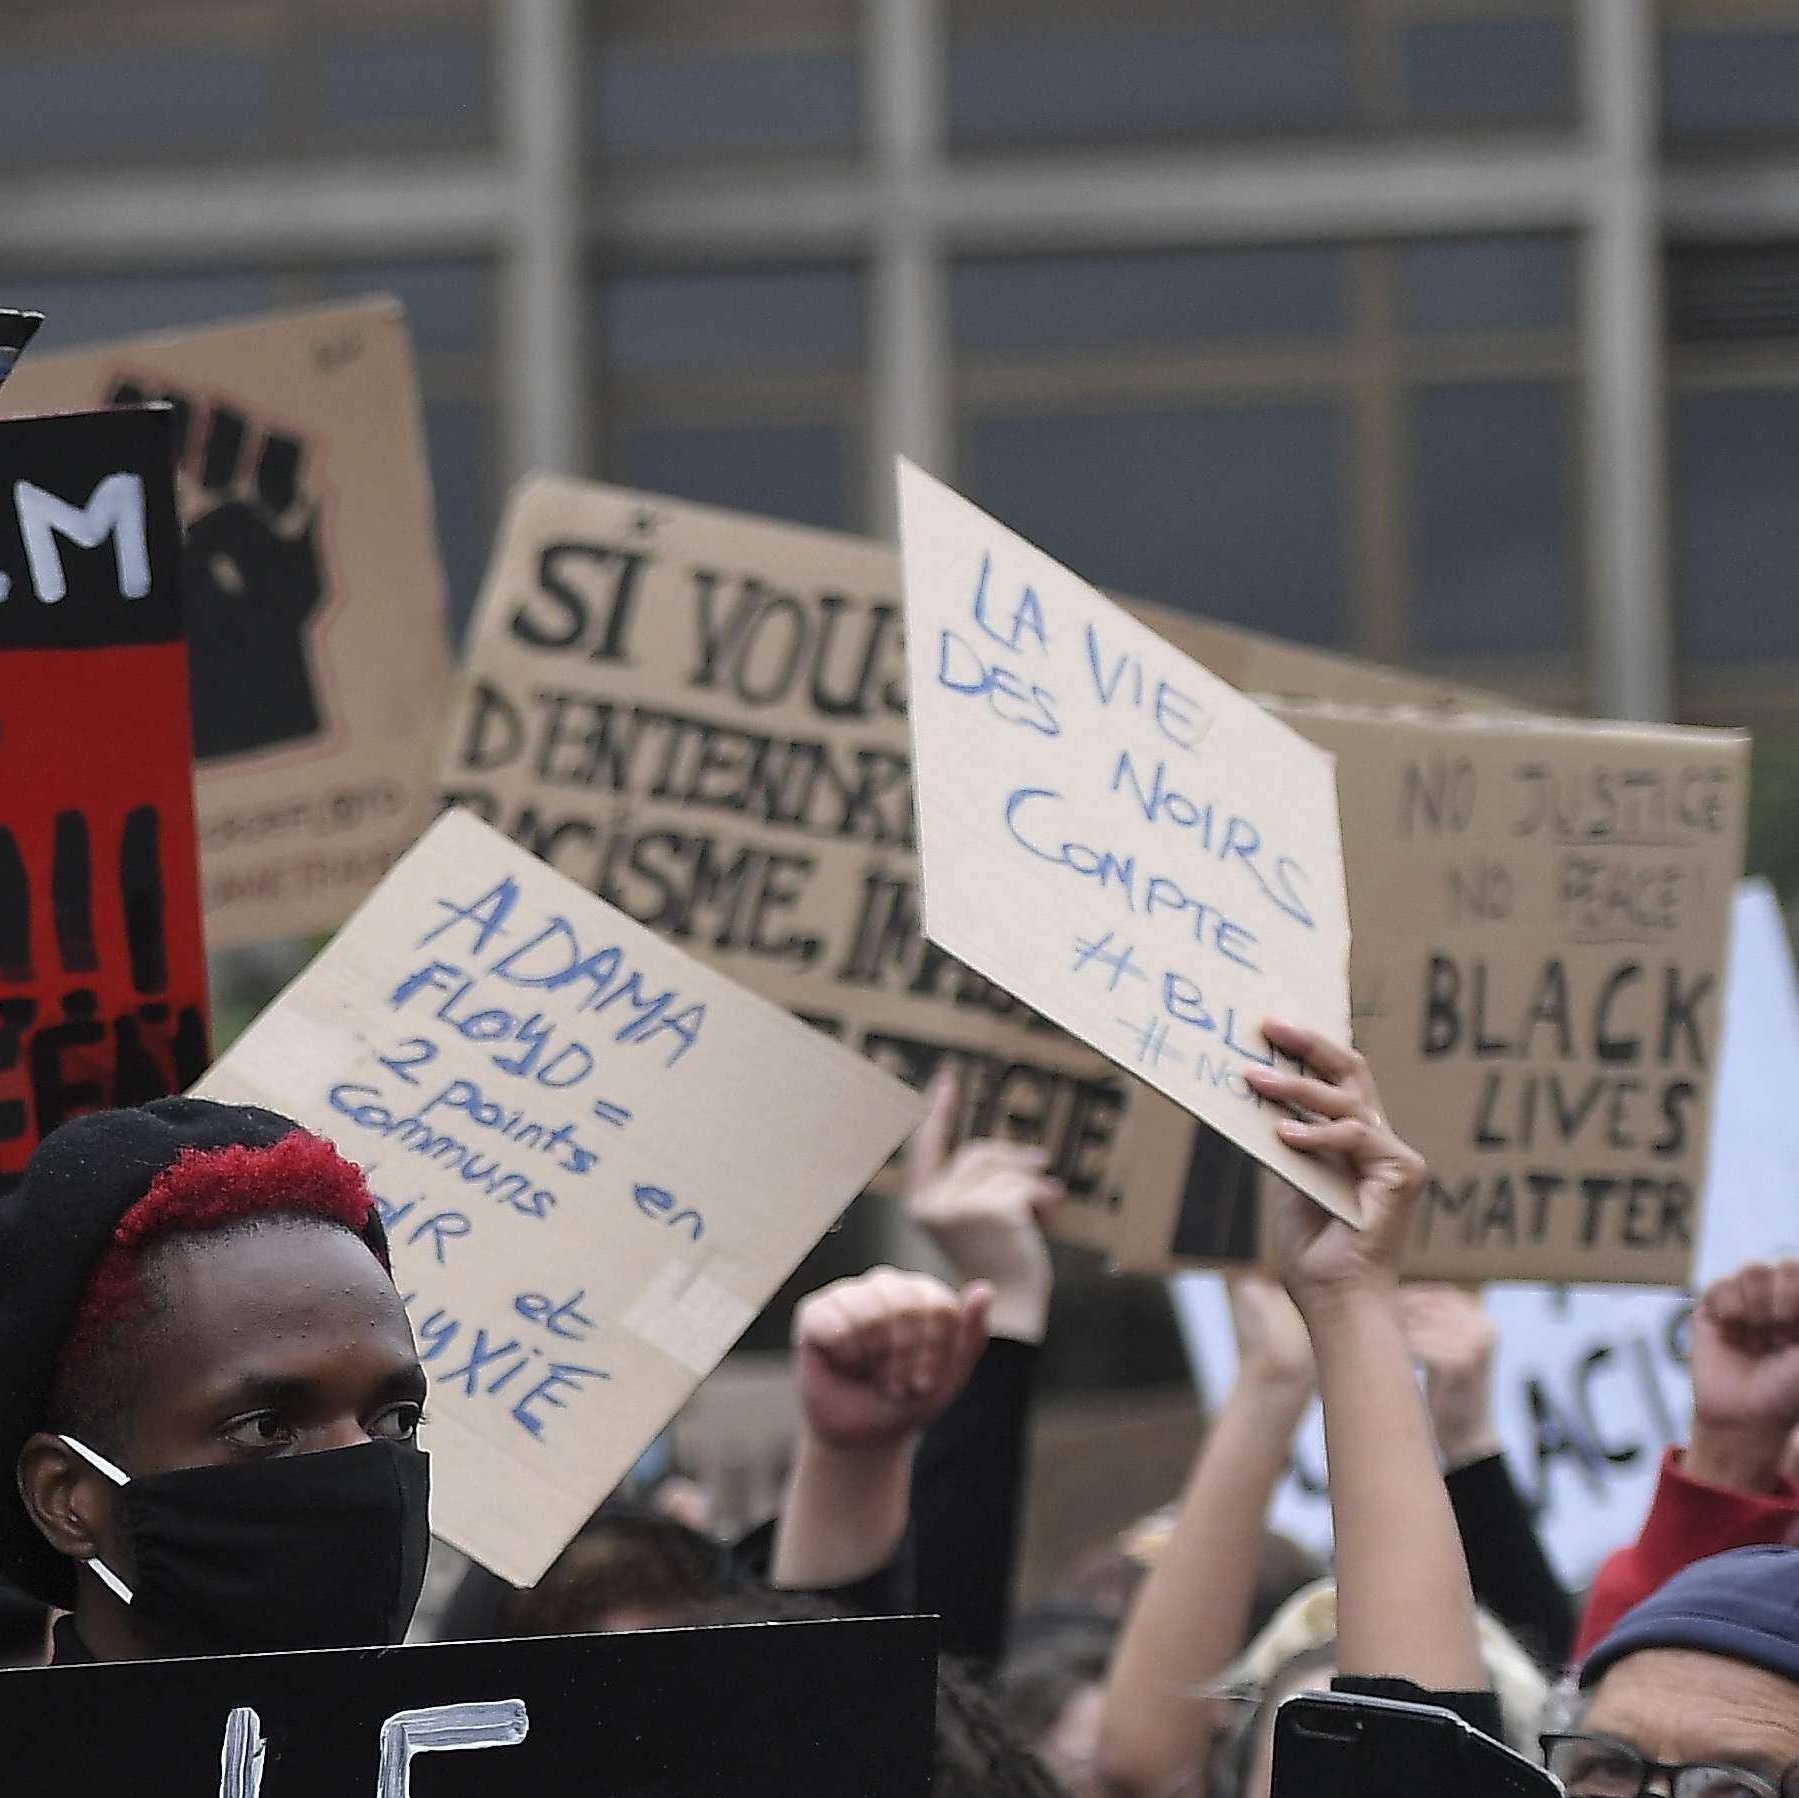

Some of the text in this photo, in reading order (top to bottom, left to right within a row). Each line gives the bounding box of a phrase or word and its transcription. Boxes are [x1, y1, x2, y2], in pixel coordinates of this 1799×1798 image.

[972, 549, 1051, 653] LA
[938, 628, 1316, 929] DES NOIRS
[1004, 784, 1266, 978] COMPTE
[412, 874, 714, 1073] ADAMA
[1419, 950, 1718, 1066] BLACK
[380, 1035, 707, 1243] 2 points en
[1472, 1070, 1697, 1160] LIVES
[1415, 1170, 1695, 1252] MATTER
[514, 1289, 595, 1341] et
